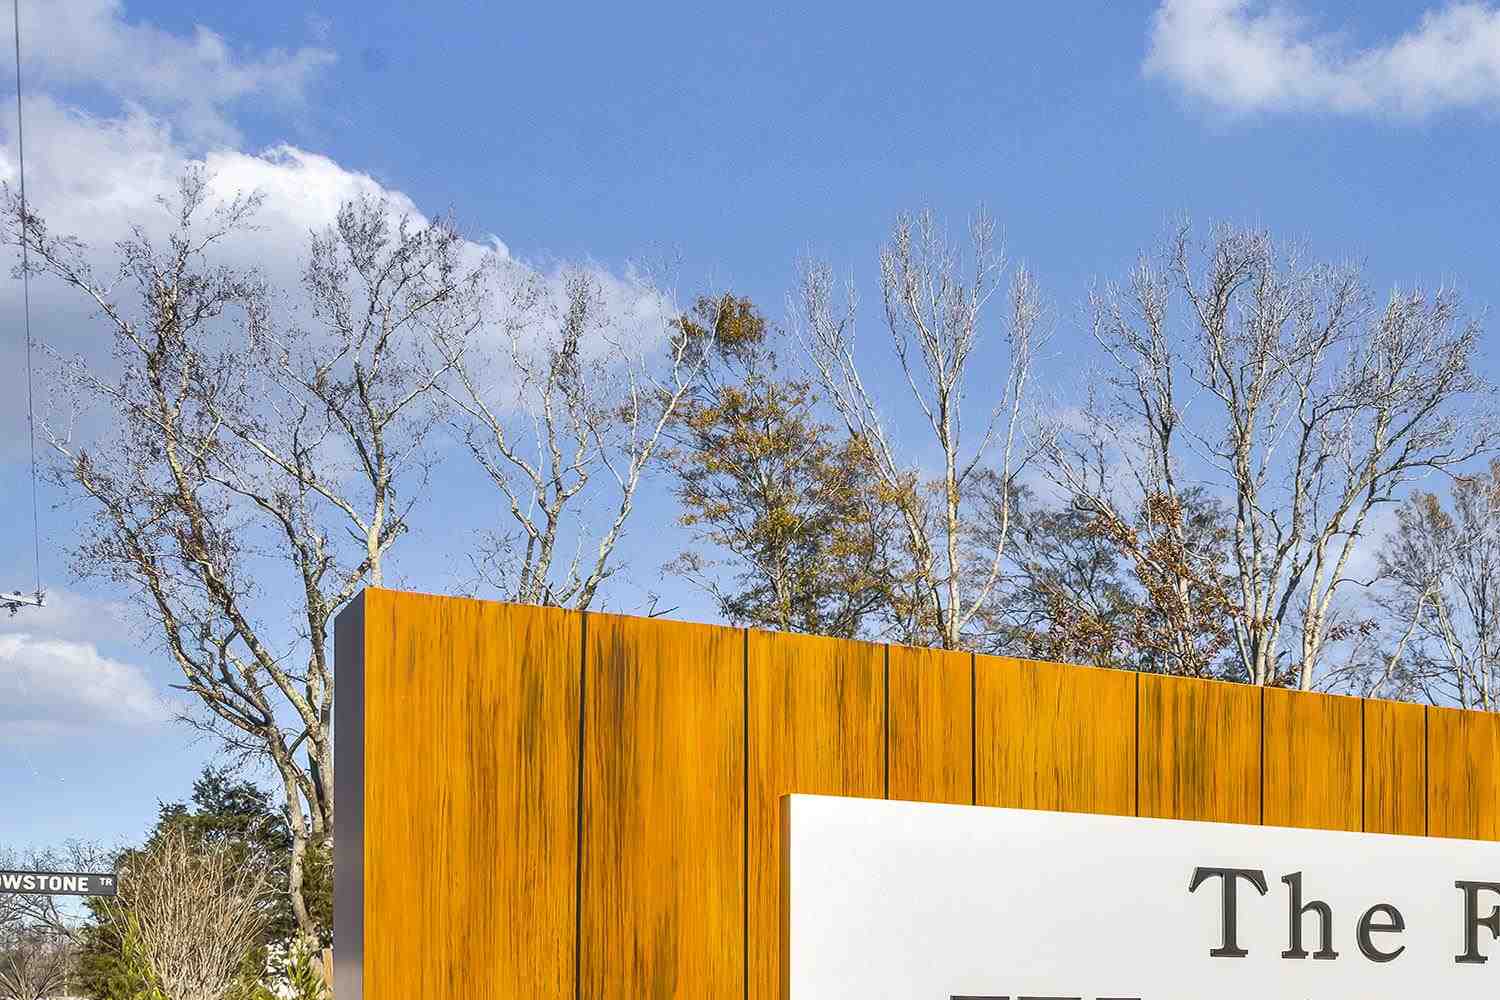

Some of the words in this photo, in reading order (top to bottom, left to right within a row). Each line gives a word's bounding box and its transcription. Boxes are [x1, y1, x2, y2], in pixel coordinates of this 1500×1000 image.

[0, 874, 89, 892] WSTONE
[100, 877, 113, 886] TR
[1189, 867, 1406, 963] The
